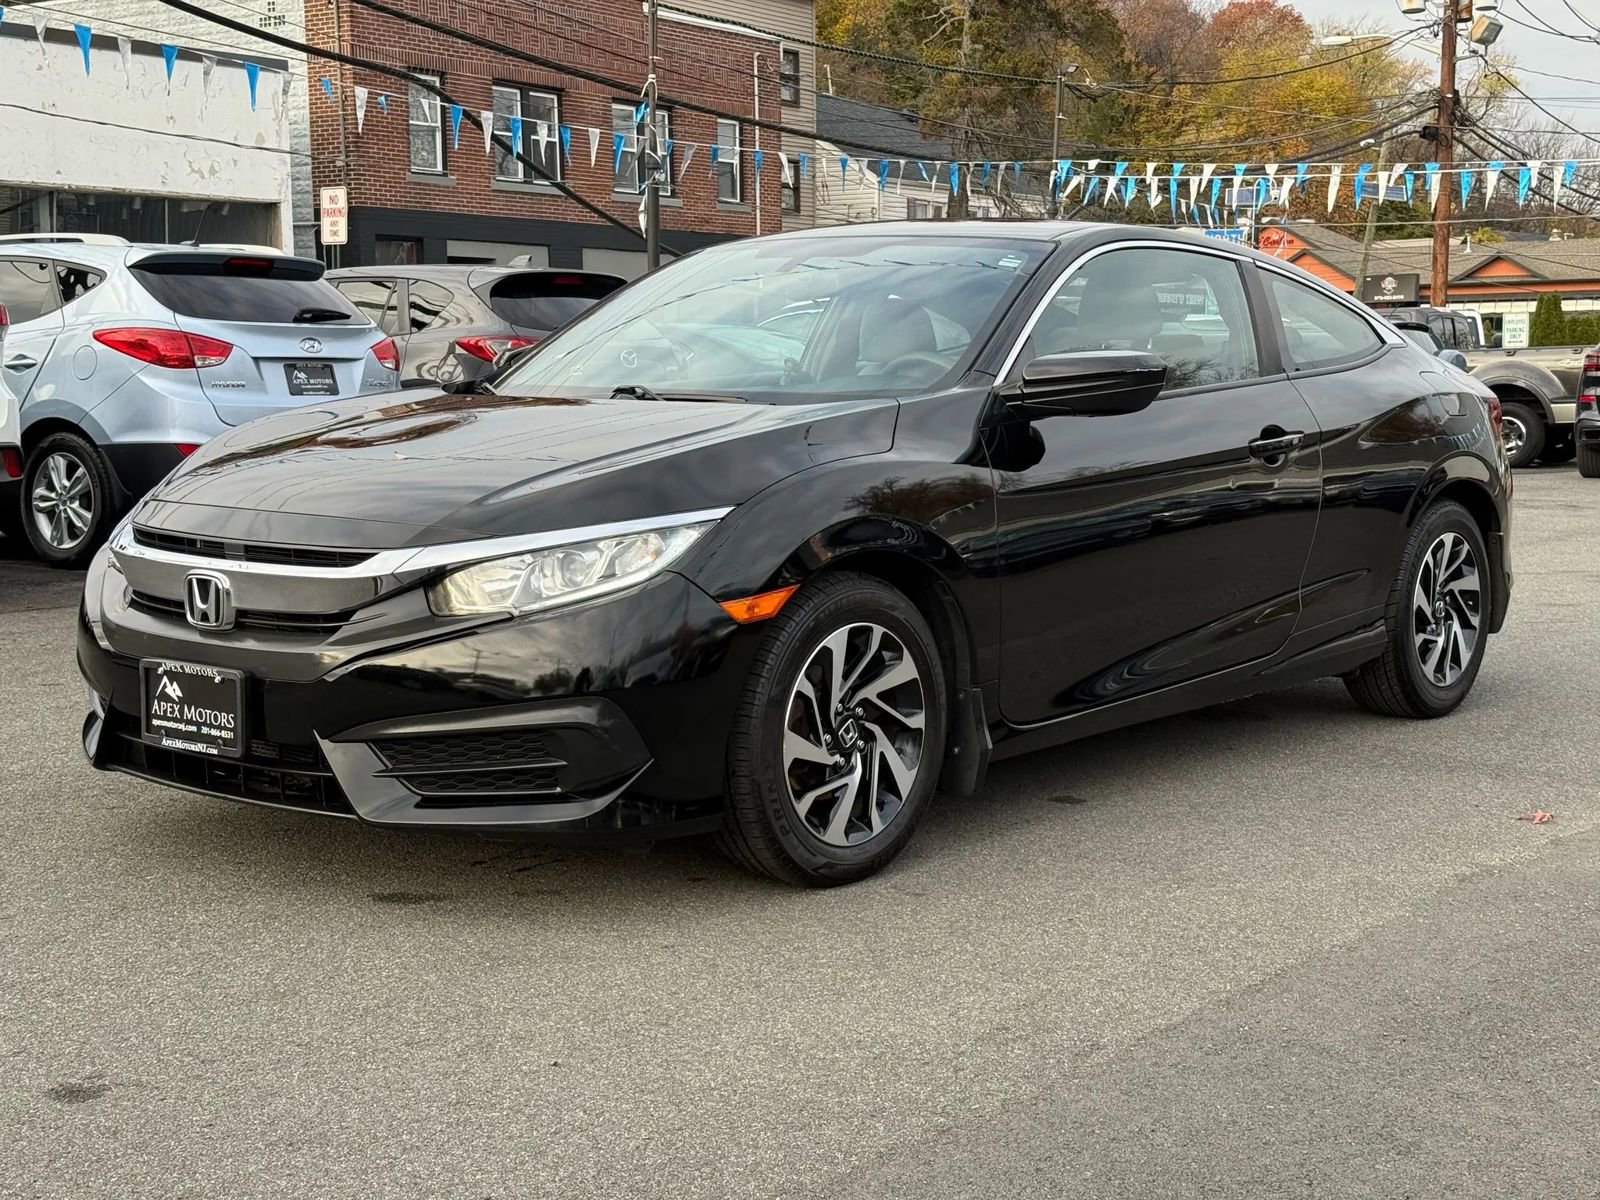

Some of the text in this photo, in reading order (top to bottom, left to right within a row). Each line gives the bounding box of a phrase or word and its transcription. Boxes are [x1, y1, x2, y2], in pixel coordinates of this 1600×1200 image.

[329, 194, 339, 205] NO
[322, 207, 345, 217] PARKING
[330, 220, 339, 228] ANY
[329, 229, 340, 237] TIME
[211, 380, 246, 389] HYUNDAI
[161, 662, 219, 679] APEX MOTORS
[152, 699, 235, 729] APEX MOTORS
